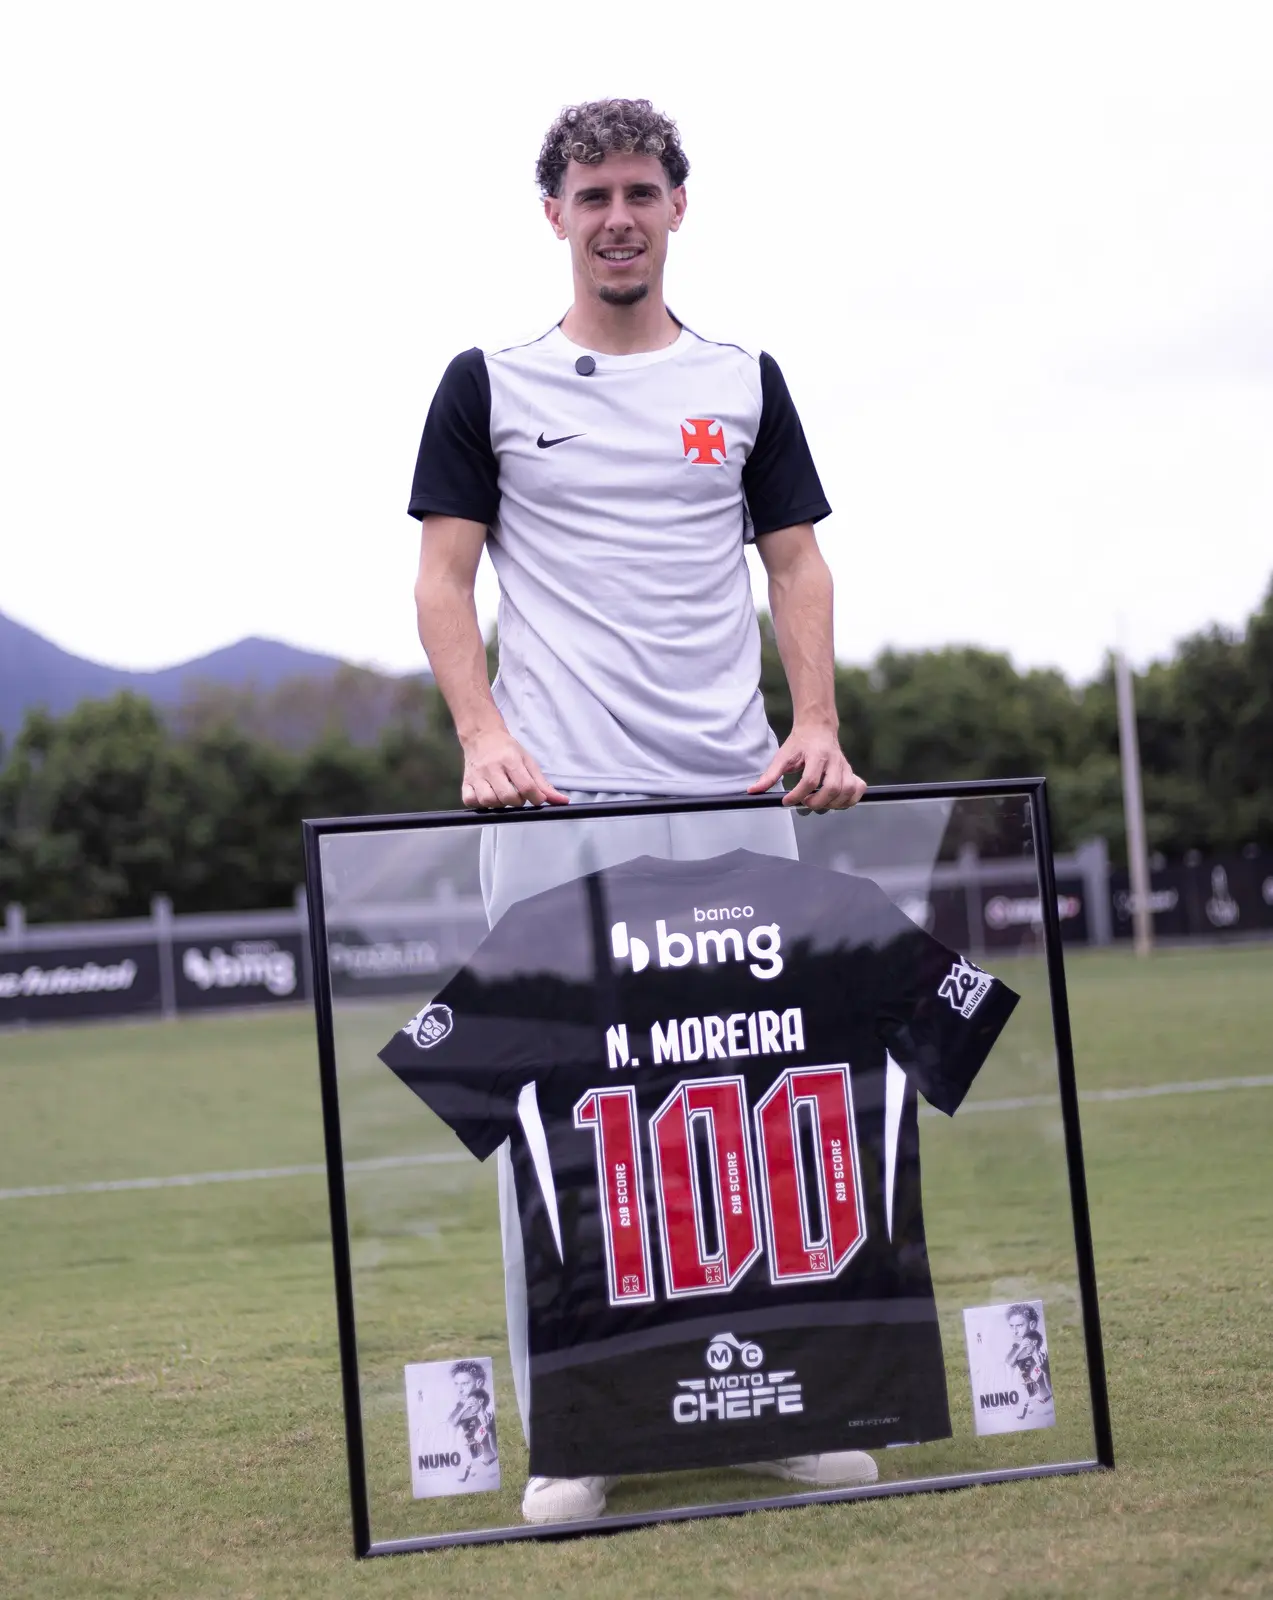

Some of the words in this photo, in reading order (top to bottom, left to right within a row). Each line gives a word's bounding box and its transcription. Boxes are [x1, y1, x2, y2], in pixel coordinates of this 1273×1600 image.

[694, 905, 754, 923] banco
[656, 919, 784, 980] bmg
[940, 966, 979, 1008] Zé
[962, 981, 988, 1017] DELIVERY
[605, 1023, 640, 1069] N.
[650, 1008, 805, 1065] MOREIRA
[727, 1151, 740, 1192] SCORE
[832, 1139, 844, 1179] SCORE
[572, 1062, 868, 1307] 100
[615, 1162, 629, 1204] SCORE
[709, 1373, 764, 1391] MOTO
[980, 1390, 1019, 1409] NUNO
[673, 1384, 804, 1423] CHEFE
[418, 1451, 461, 1470] NUNO
